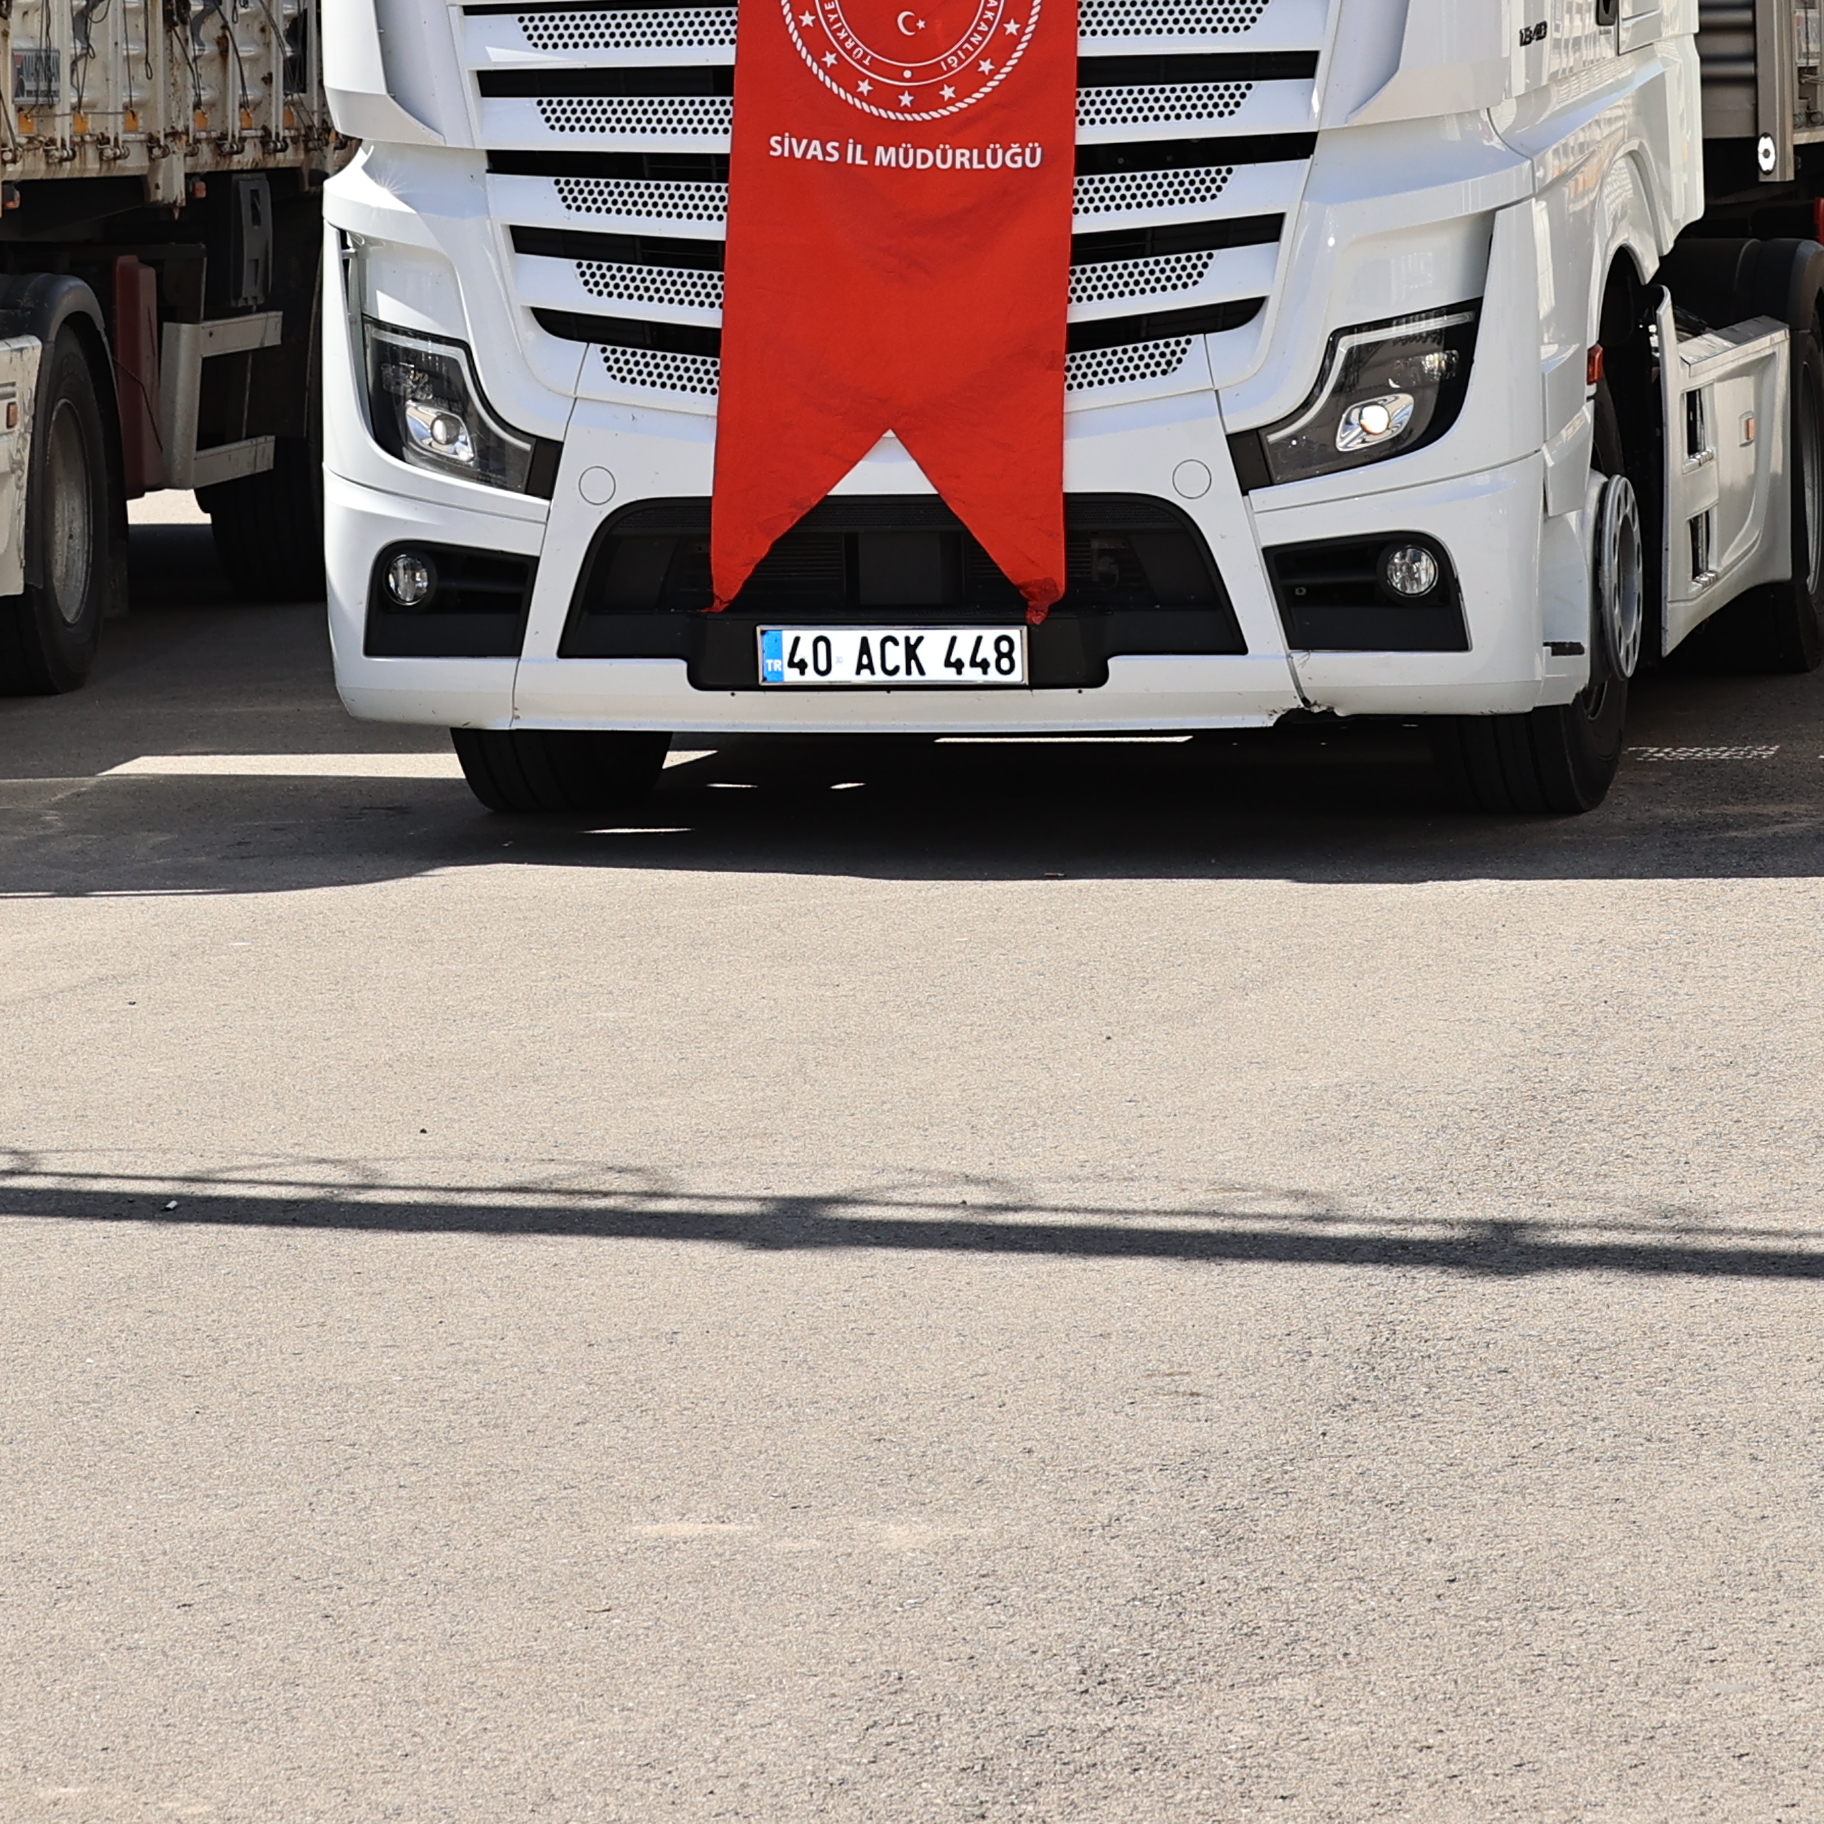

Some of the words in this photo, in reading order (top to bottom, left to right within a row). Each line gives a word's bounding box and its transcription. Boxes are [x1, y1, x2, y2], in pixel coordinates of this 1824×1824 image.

[824, 1, 873, 66] TÜRKİYE
[769, 132, 840, 162] SİVAS
[846, 138, 868, 165] İL
[874, 142, 1042, 170] MÜDÜRLÜĞÜ
[766, 659, 782, 672] TR
[787, 635, 832, 676] 40
[855, 635, 926, 676] ACK
[944, 635, 1015, 676] 448
